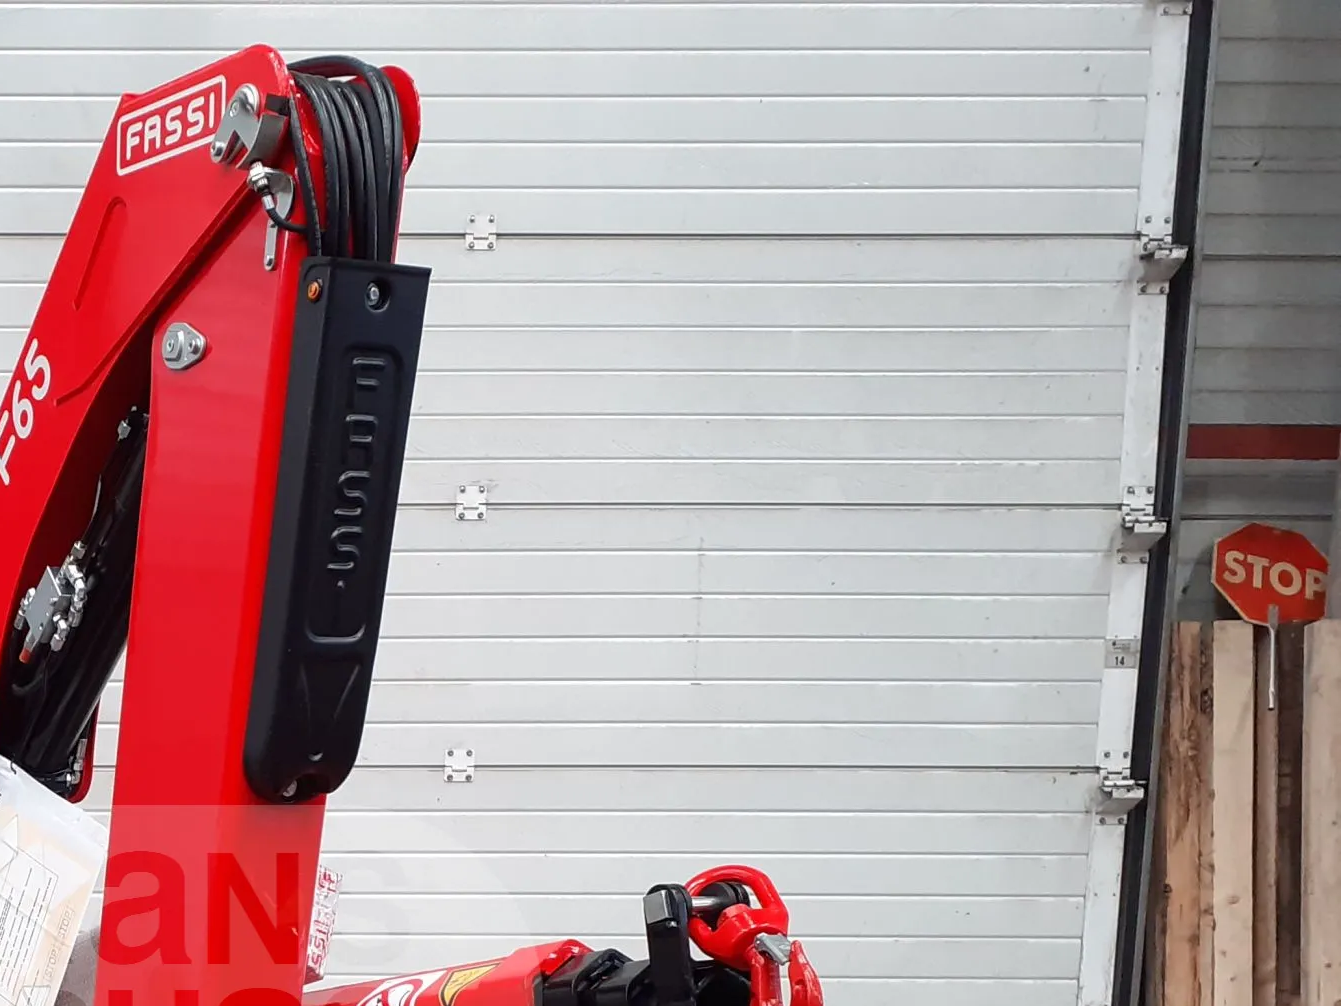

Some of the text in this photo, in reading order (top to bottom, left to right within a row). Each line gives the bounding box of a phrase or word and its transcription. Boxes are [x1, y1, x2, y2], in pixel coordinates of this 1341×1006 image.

[125, 91, 215, 161] FASSI
[1222, 550, 1328, 601] STOP
[1114, 655, 1125, 666] 14
